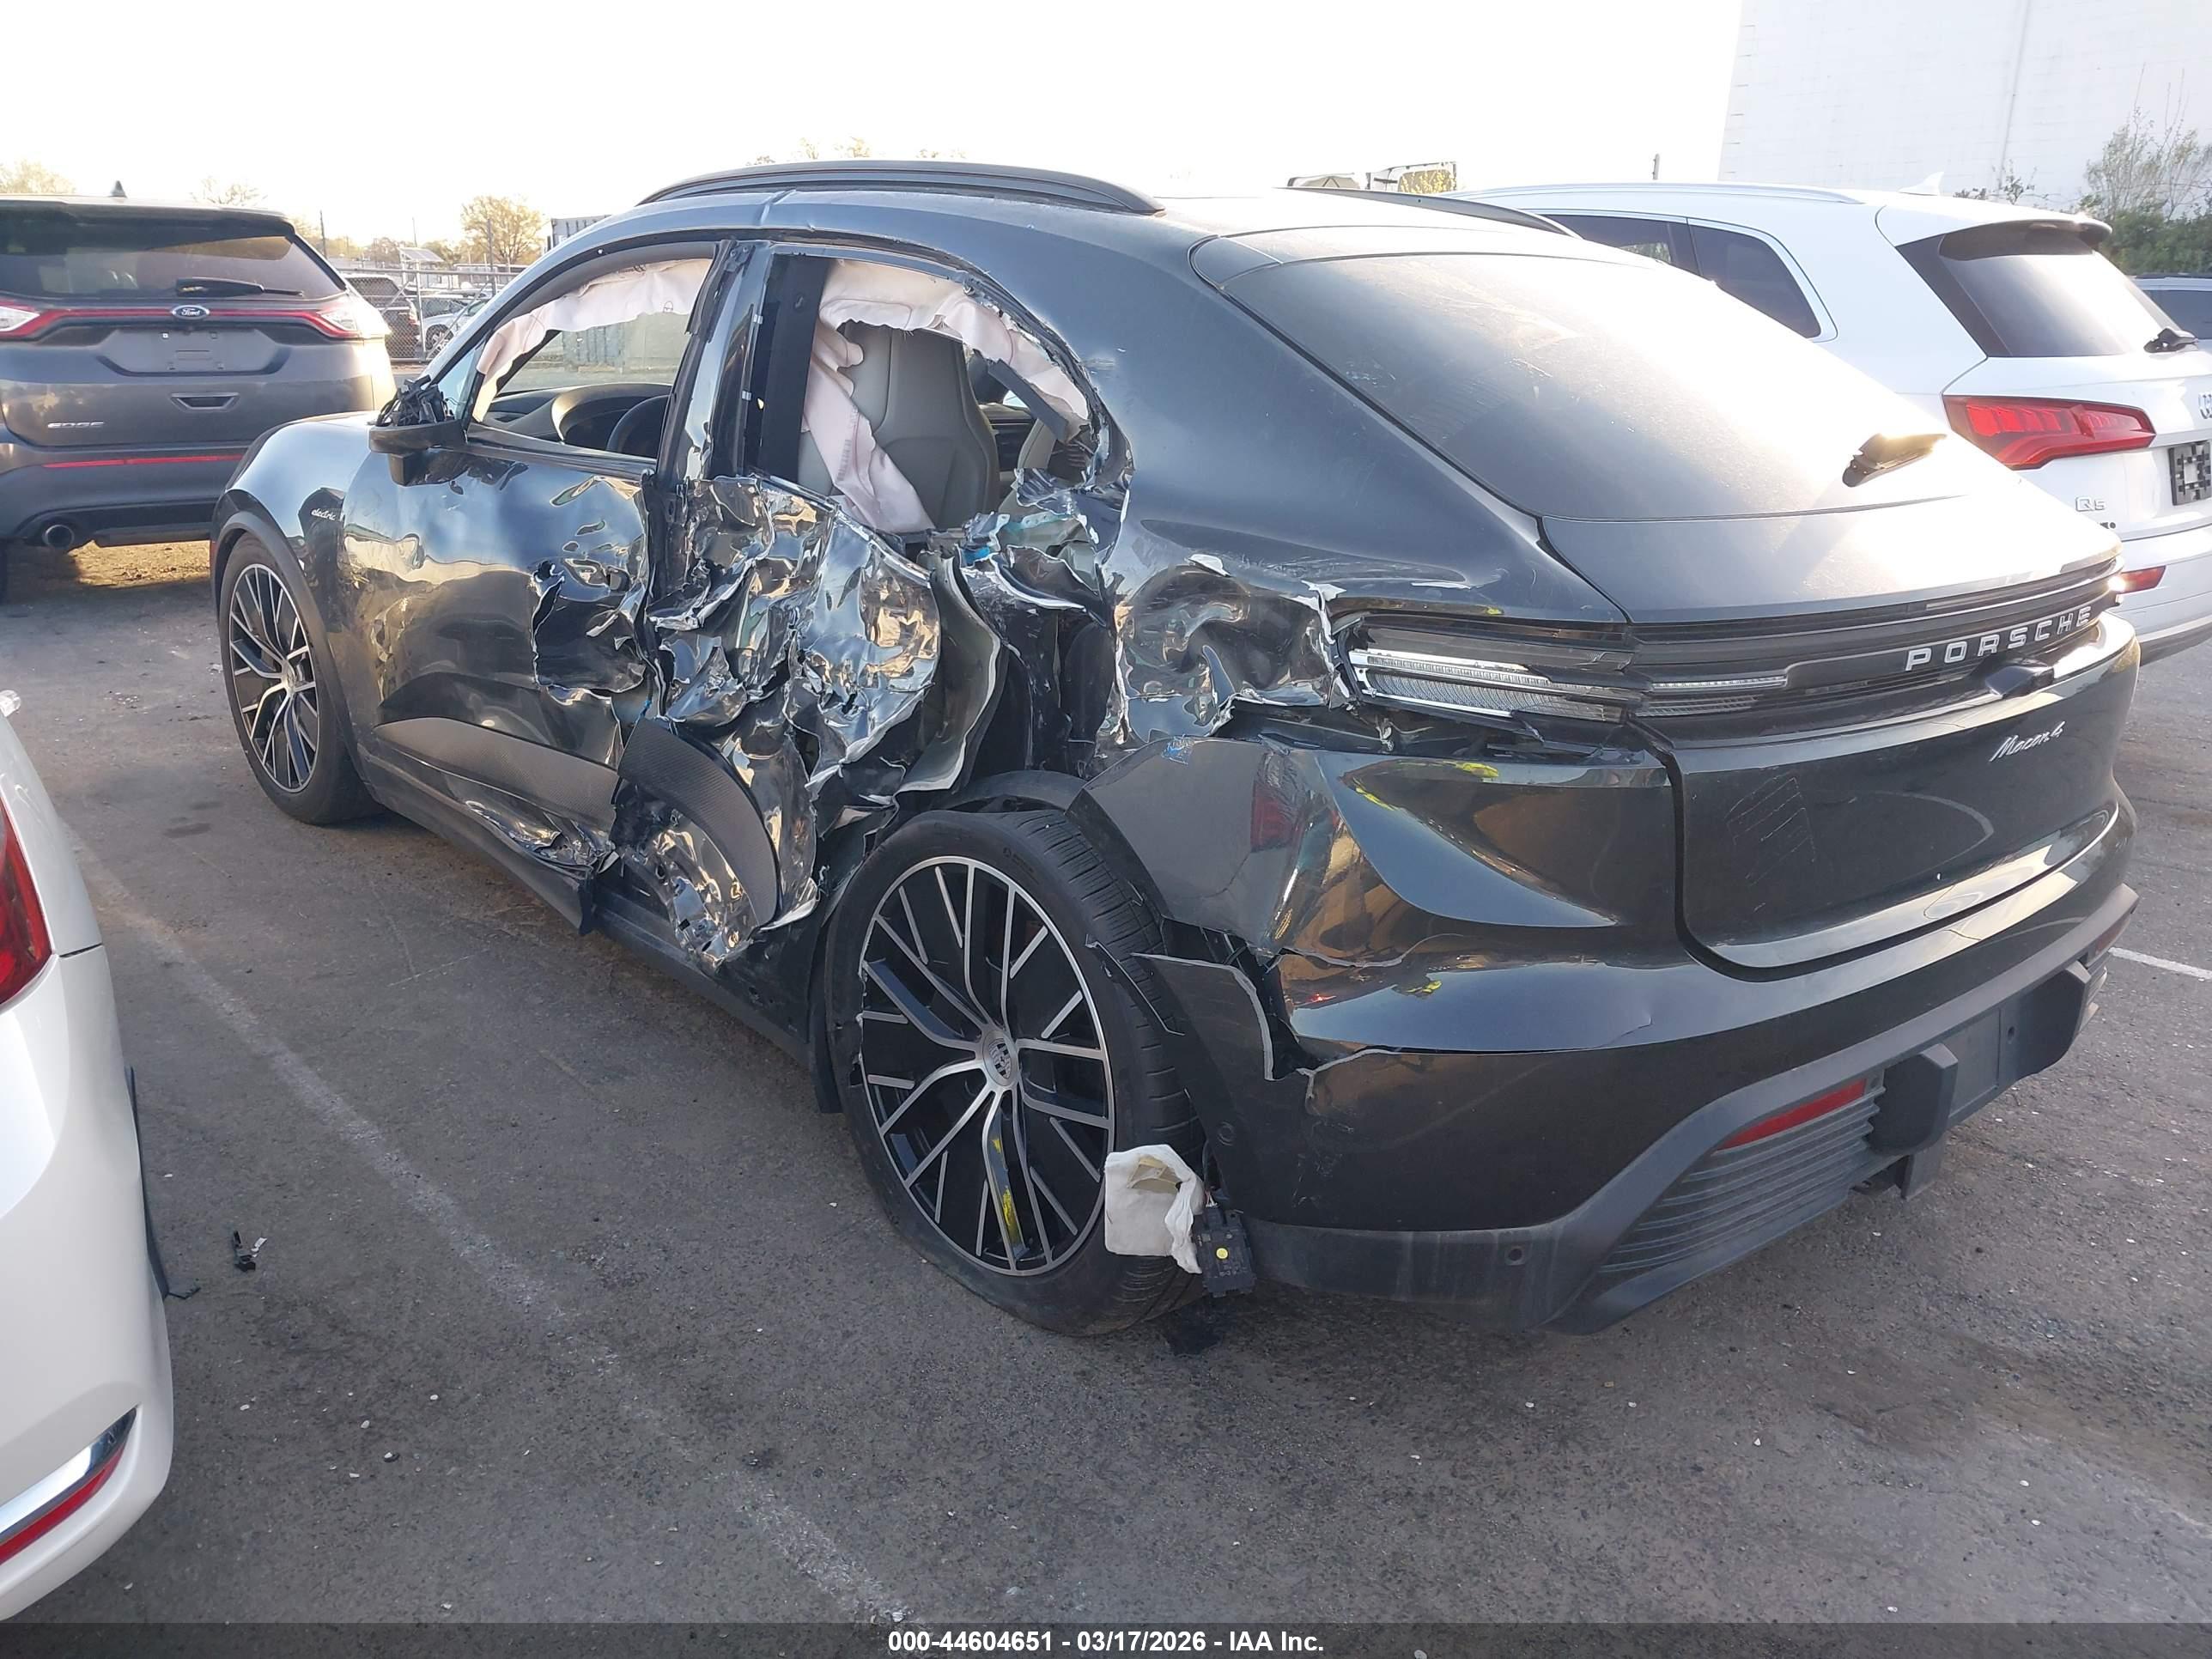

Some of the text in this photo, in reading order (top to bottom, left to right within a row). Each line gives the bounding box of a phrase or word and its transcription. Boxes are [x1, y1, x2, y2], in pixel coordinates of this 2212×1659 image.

[2075, 496, 2106, 512] Q5
[311, 507, 337, 520] electric
[1905, 606, 2091, 672] PORSCHE
